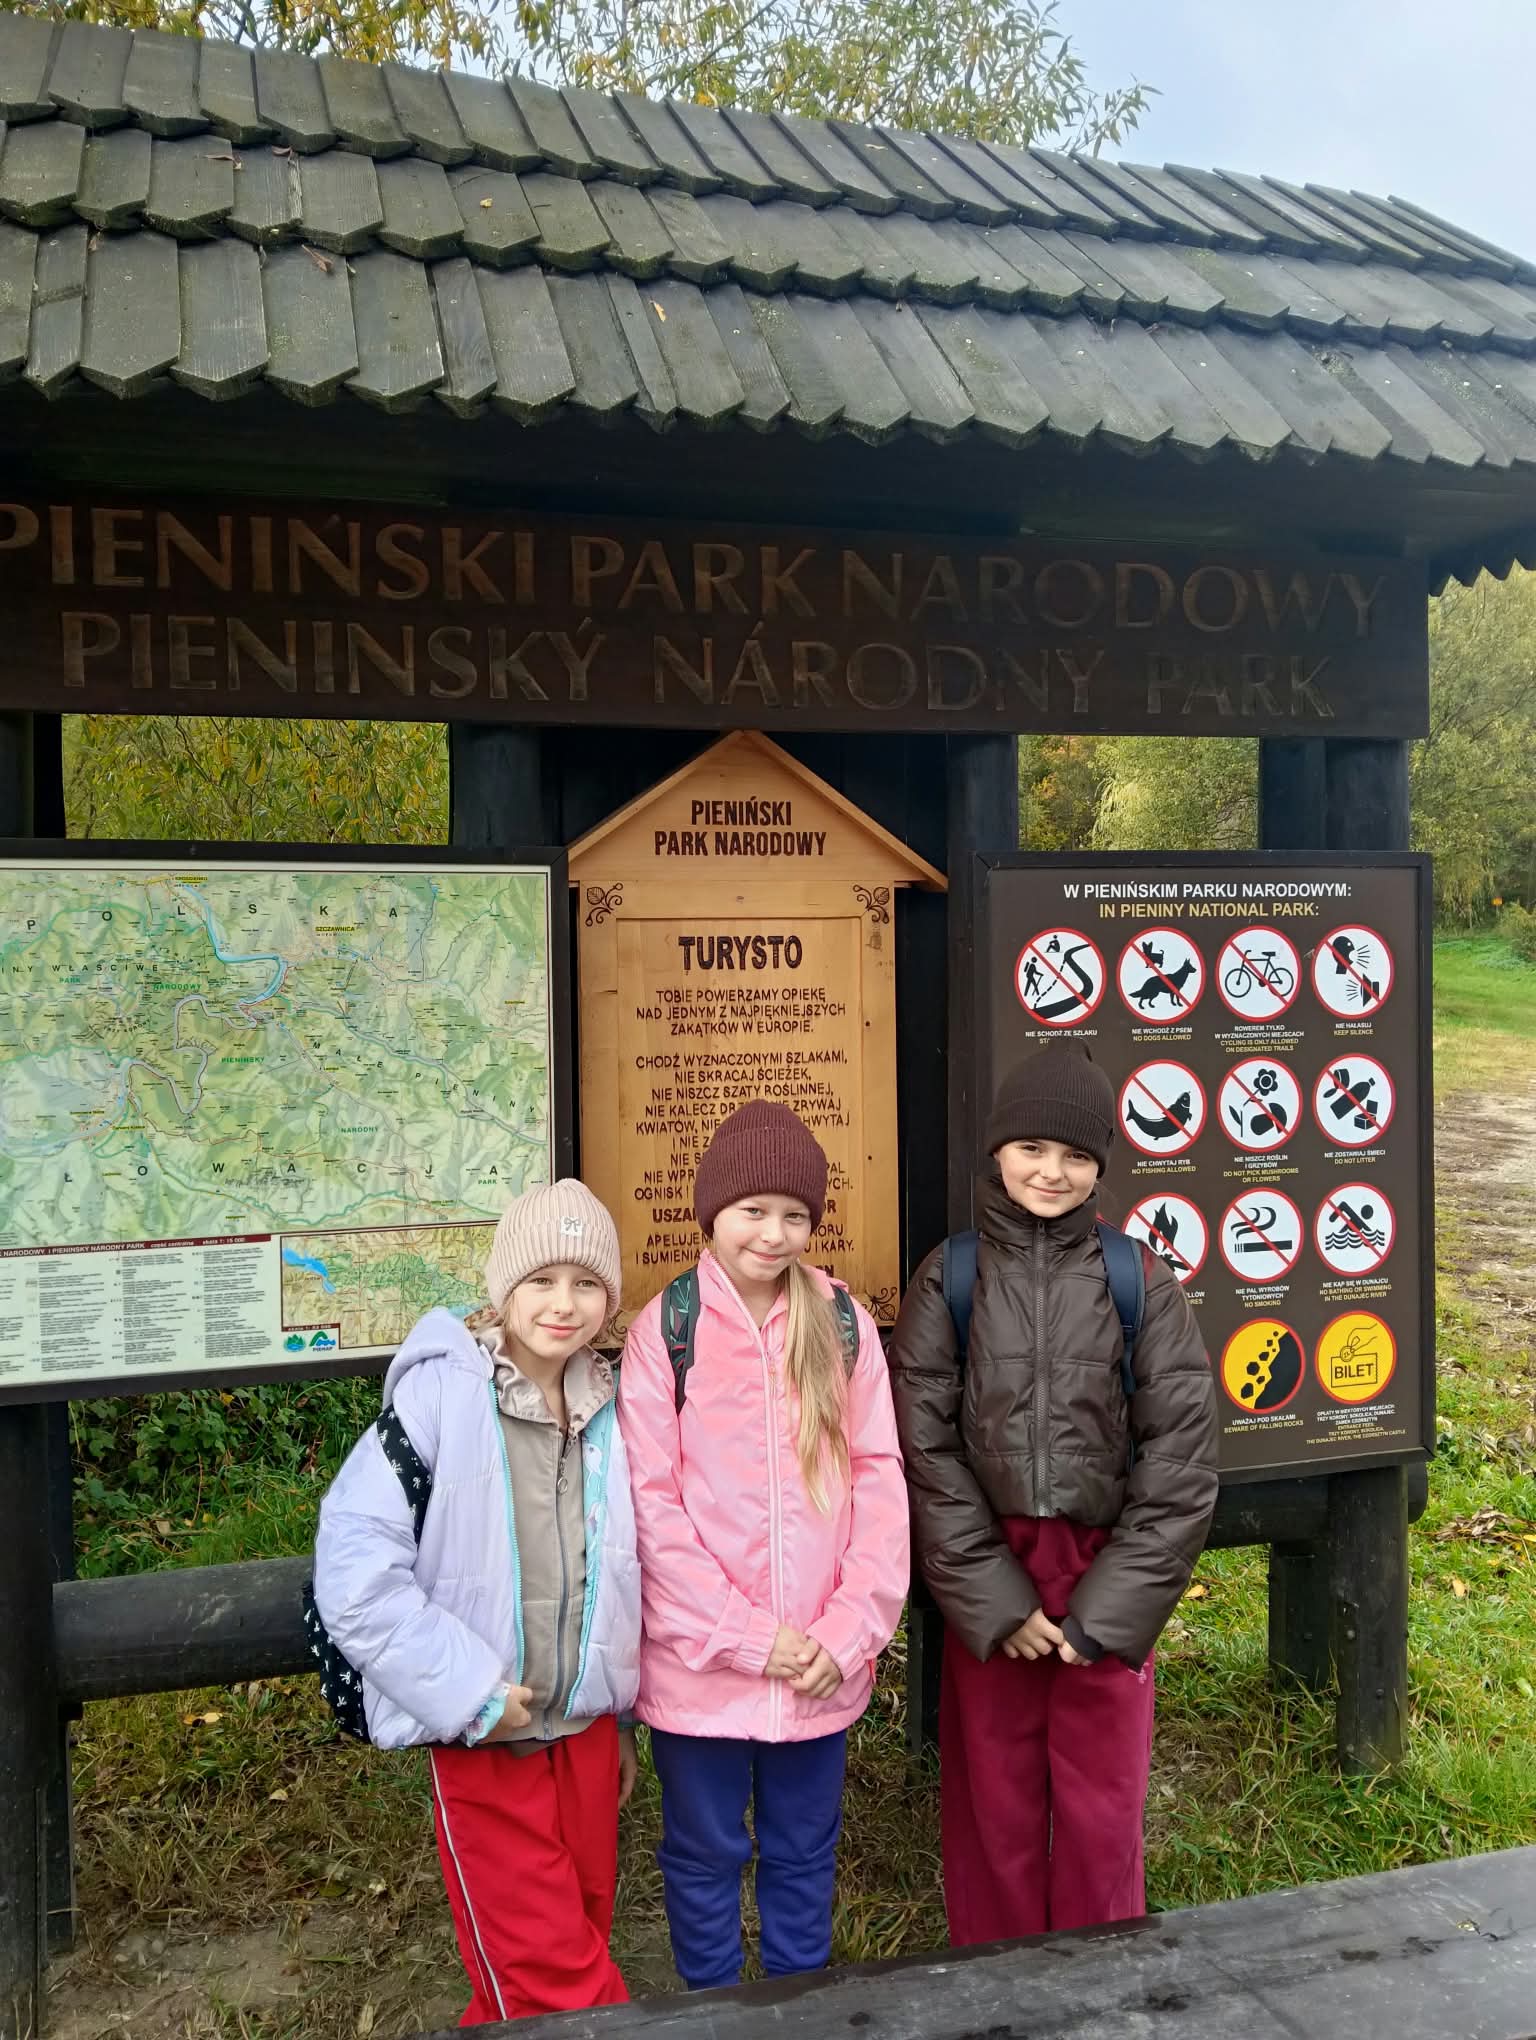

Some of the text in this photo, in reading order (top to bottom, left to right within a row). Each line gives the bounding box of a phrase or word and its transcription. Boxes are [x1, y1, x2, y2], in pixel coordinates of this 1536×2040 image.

[0, 503, 1386, 636] PIENIŃSKI PARK NARODOWY
[61, 611, 606, 701] PIENINSKÝ
[1146, 651, 1334, 718] PARK
[691, 796, 792, 826] PIENIŃSKI
[654, 831, 827, 856] PARK NARODOWY
[1063, 880, 1352, 899] W PIENIŃSKIM PARKU NARODOWYM:
[1099, 902, 1320, 918] IN PIENINY NATIONAL PARK:
[678, 935, 802, 970] TURYSTO
[656, 988, 826, 1004] TOBIE POWIERZAMY OPIEKĘ
[636, 1003, 846, 1021] NAD JEDNYM Z NAJPIĘKNIEJSZYCH
[671, 1020, 814, 1037] ZAKĄTKÓW W EUROPIE.
[636, 1050, 848, 1069] CHODŹ WYZNACZONYMI SZLAKAMI,
[675, 1066, 812, 1083] NIE SKRACAJ ŚCIEŻEK,
[652, 1082, 834, 1100] NIE NISZCZ SZATY ROŚLINNEJ,
[645, 1104, 665, 1117] NIE
[669, 1102, 716, 1116] KALECZ
[793, 1099, 841, 1112] ZRYWAJ
[636, 1112, 849, 1136] KWIATÓW, NIE HWYTAJ
[680, 1136, 699, 1149] NIE
[670, 1153, 689, 1167] NIE
[1166, 1165, 1197, 1173] ALLOWED
[644, 1170, 664, 1184] NIE
[635, 1187, 682, 1200] OGNISK
[642, 1248, 701, 1265] SUMIENIA
[821, 1239, 854, 1253] KARY.
[1334, 1362, 1374, 1380] BILET
